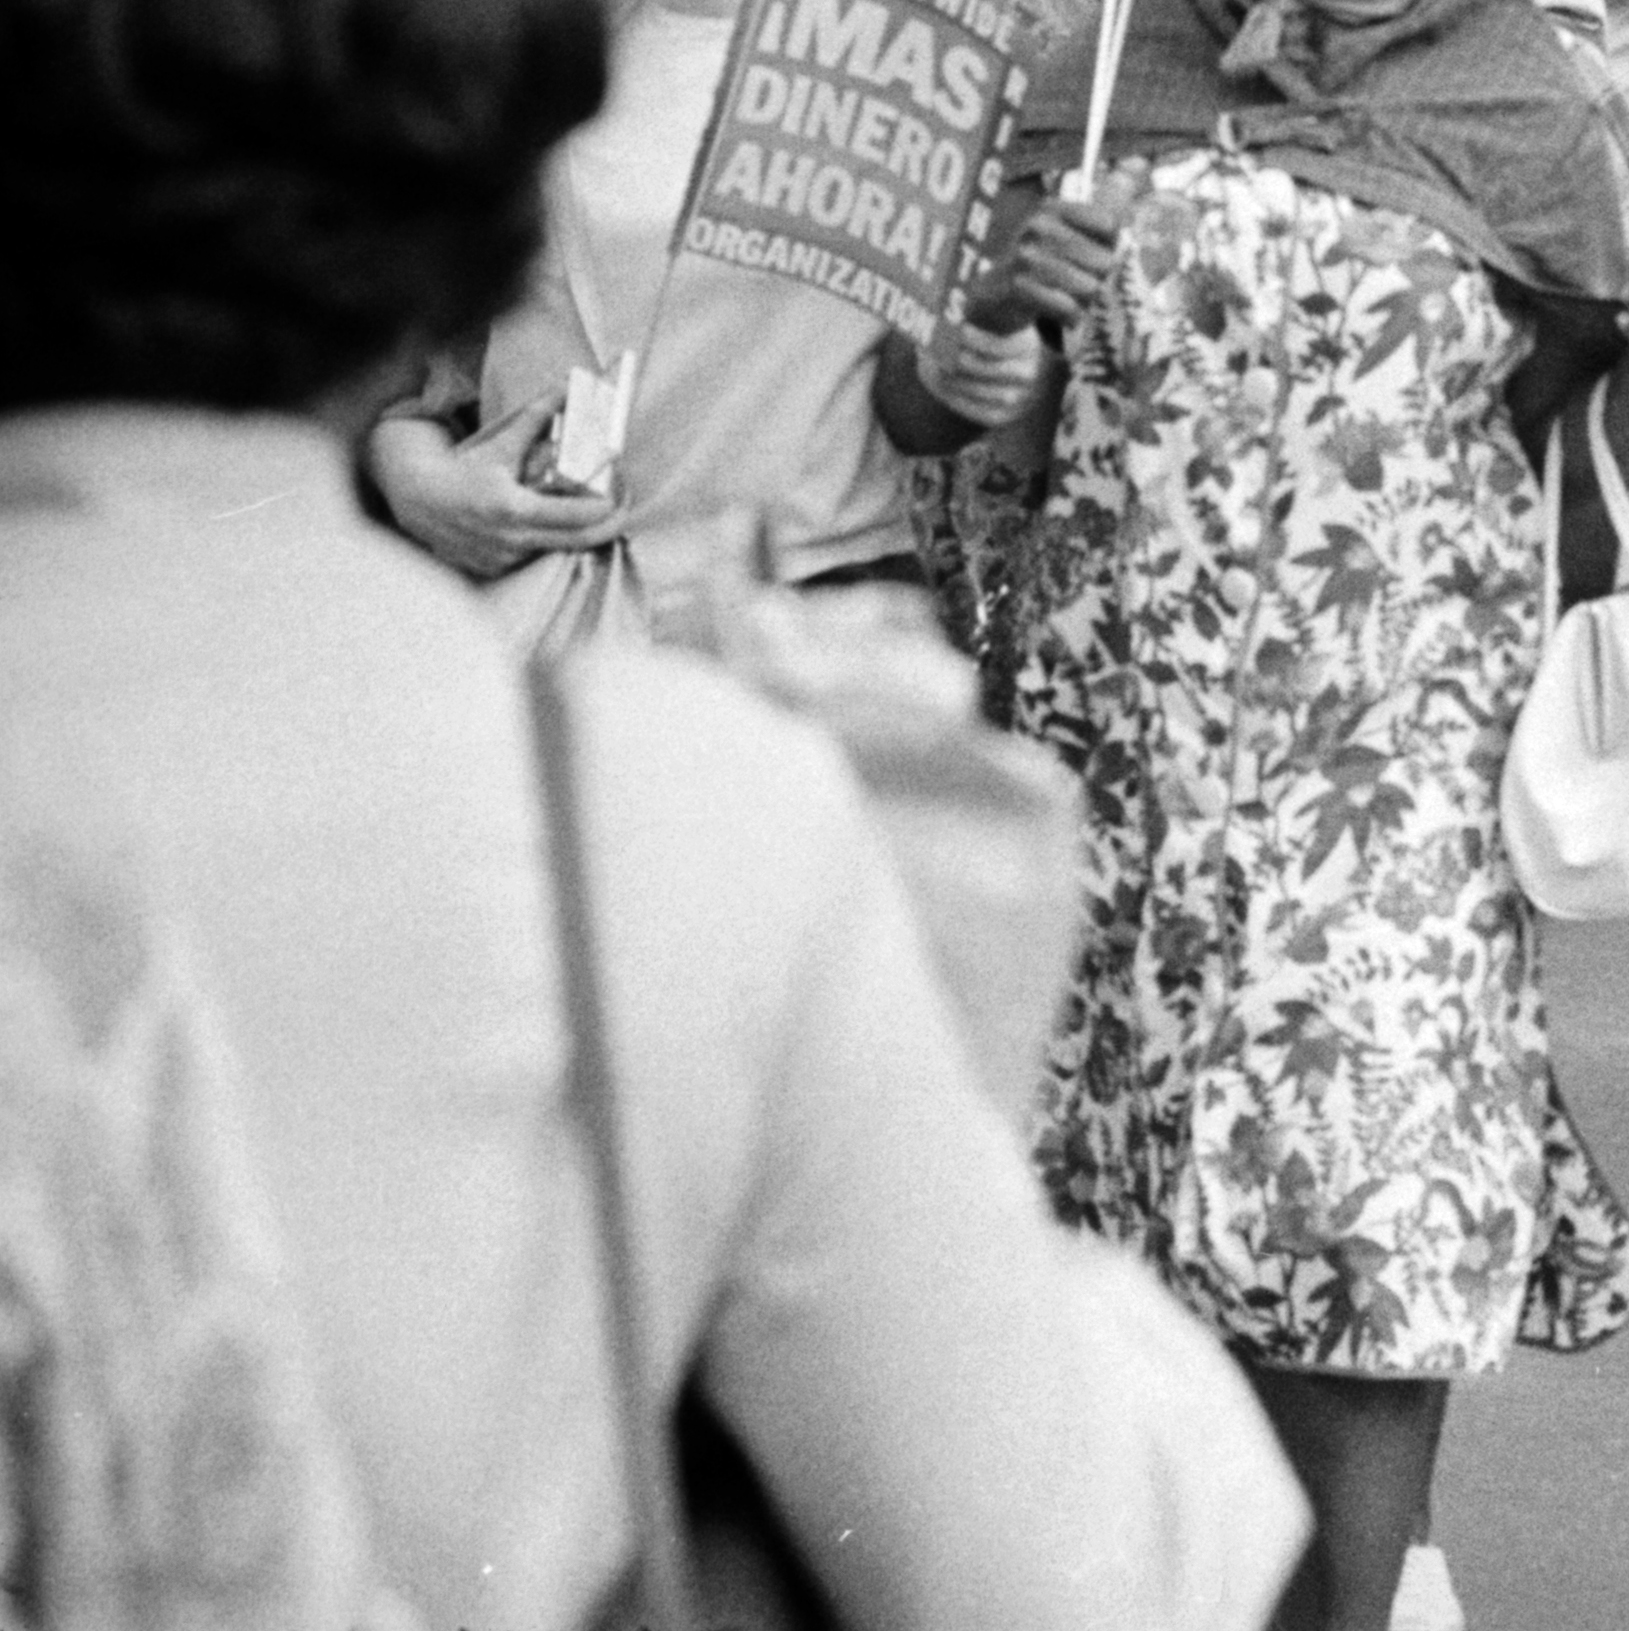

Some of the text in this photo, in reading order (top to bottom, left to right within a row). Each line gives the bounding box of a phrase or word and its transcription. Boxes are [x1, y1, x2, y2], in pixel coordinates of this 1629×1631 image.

[735, 64, 966, 205] DINERO
[943, 64, 1029, 326] RIGHTS
[687, 216, 937, 347] ORGANIZATION
[714, 140, 947, 282] AHORA!
